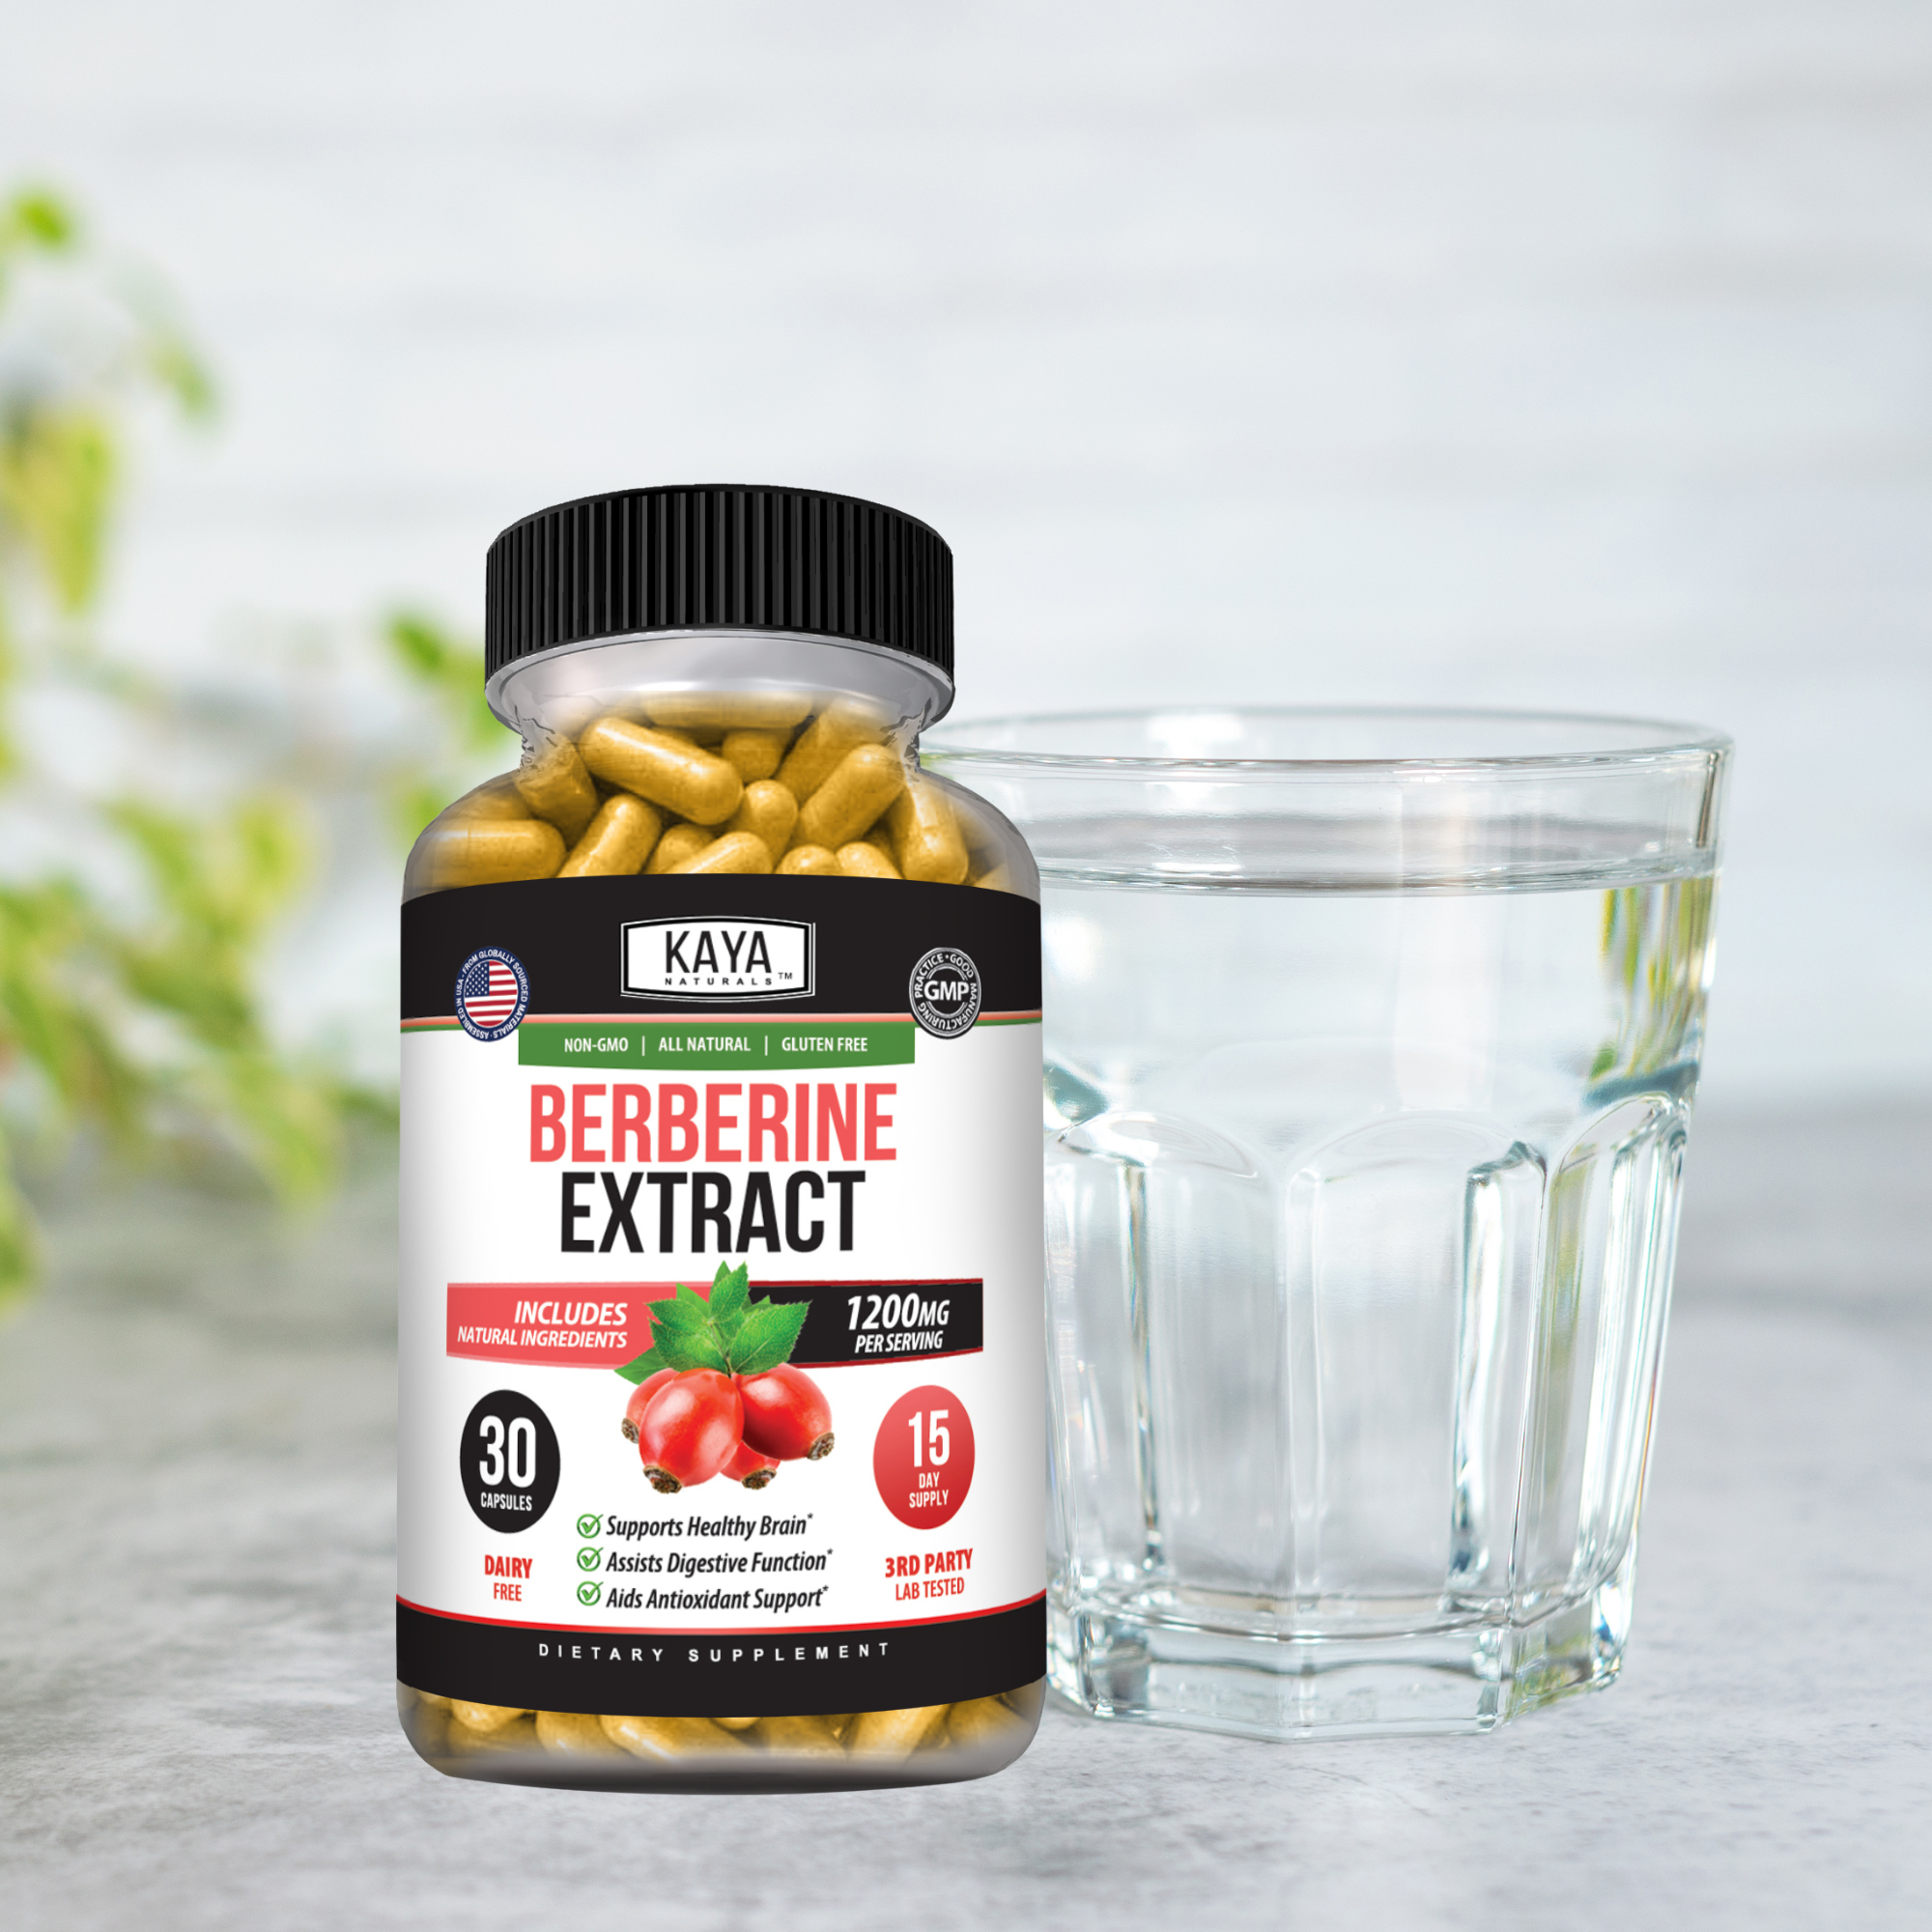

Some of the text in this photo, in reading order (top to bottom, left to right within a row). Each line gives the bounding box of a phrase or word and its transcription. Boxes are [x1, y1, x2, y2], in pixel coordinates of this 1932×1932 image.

[666, 930, 772, 974] KAYA
[456, 949, 528, 1039] ASSEMBLED IN USA FROM GLOBALLY SOURCED MATERIALS
[665, 977, 773, 986] NATURALS
[914, 952, 978, 1031] GOOD MANUFACTURING PRACTICE
[923, 980, 970, 1001] GMP
[564, 1037, 629, 1052] NON-GMO
[659, 1037, 752, 1052] ALL NATURAL
[781, 1037, 868, 1052] GLUTEN FREE
[529, 1083, 897, 1163] BERBERINE
[560, 1170, 866, 1253] EXTRACT
[514, 1301, 629, 1326] INCLUDES
[847, 1293, 951, 1330] 1200MG
[457, 1325, 628, 1349] NATURAL INGREDIENTS
[854, 1330, 944, 1353] PER SERVING
[908, 1409, 951, 1467] 15
[479, 1415, 537, 1488] 30
[919, 1471, 940, 1489] DAY
[480, 1492, 533, 1512] CAPSULES
[909, 1490, 949, 1508] SUPPLY
[606, 1515, 684, 1542] Supports
[687, 1515, 757, 1542] Healthy
[484, 1554, 533, 1579] DAIRY
[606, 1551, 664, 1573] Assists
[667, 1552, 748, 1578] Digestive
[885, 1548, 974, 1578] 3RD PARTY
[494, 1582, 523, 1603] FREE
[606, 1587, 643, 1609] Aids
[645, 1588, 751, 1610] Antioxidant
[895, 1577, 965, 1602] LAB TESTED
[538, 1642, 889, 1663] DIETARY SUPPLEMENT
